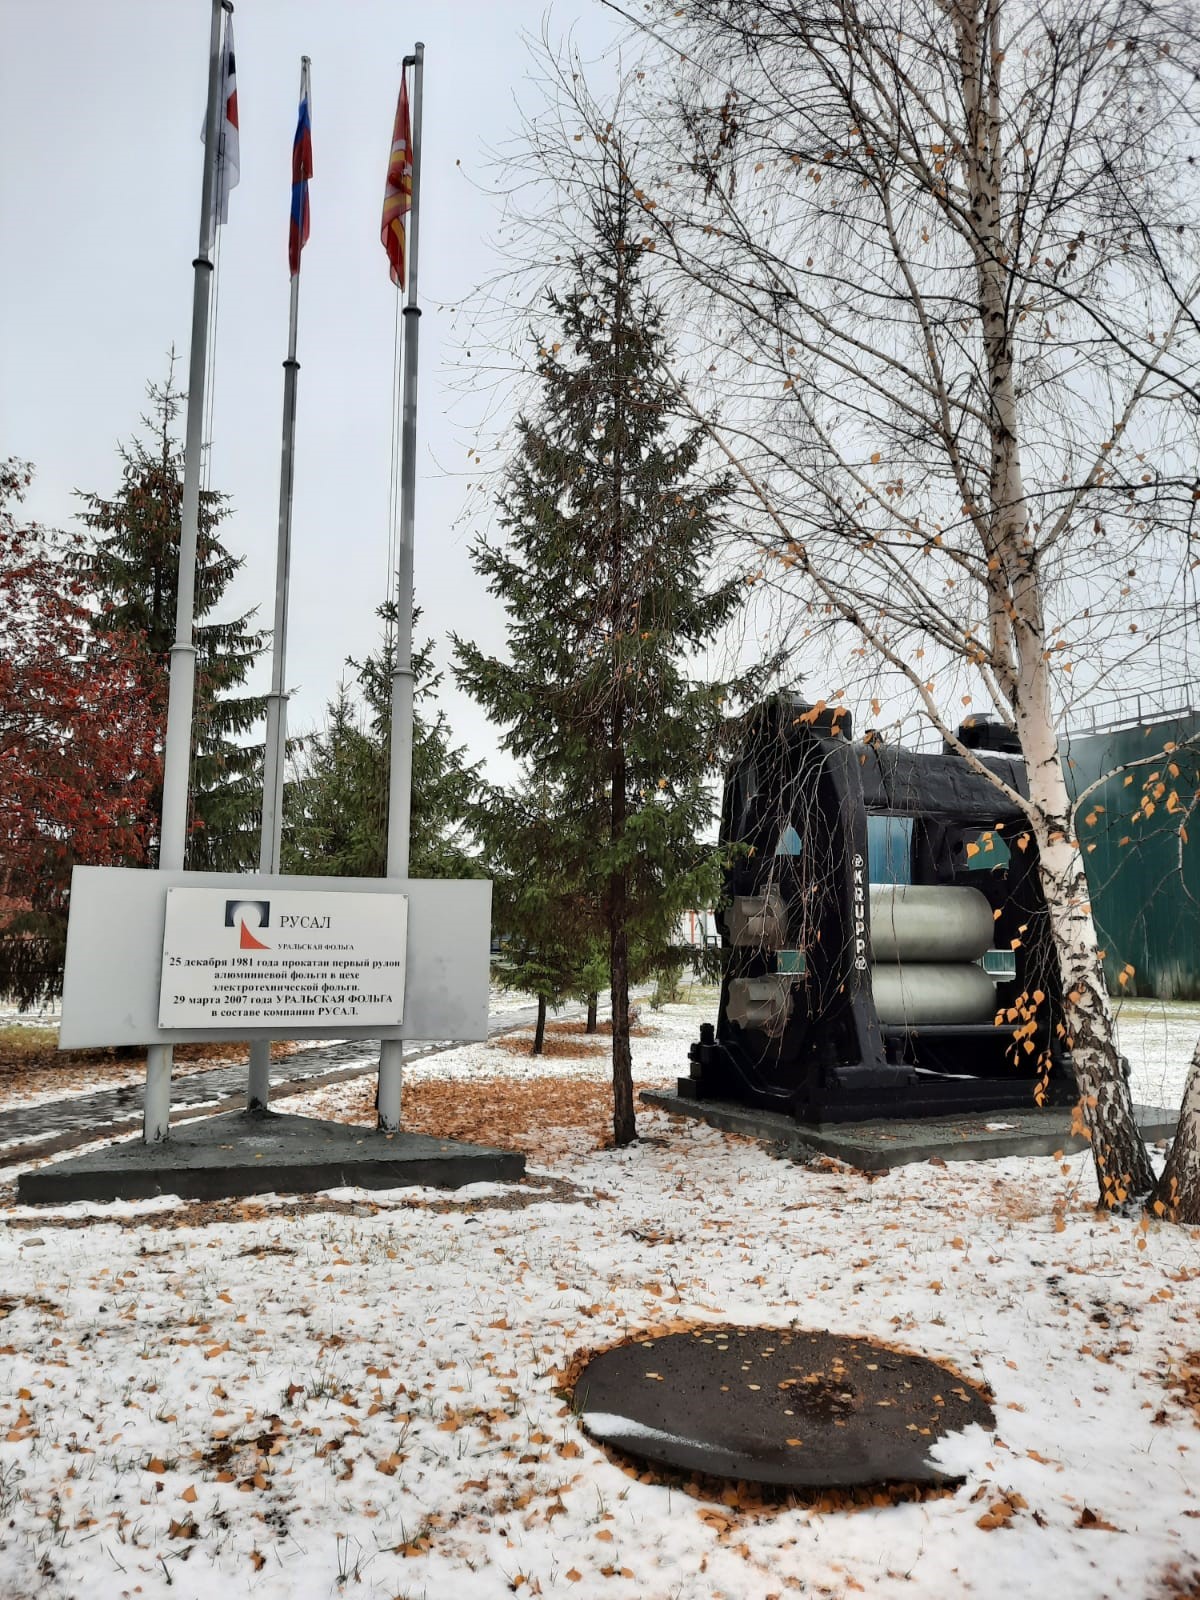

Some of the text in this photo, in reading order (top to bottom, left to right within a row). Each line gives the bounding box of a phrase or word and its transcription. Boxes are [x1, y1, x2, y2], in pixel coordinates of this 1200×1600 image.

[854, 870, 865, 953] KRUPP
[280, 915, 331, 929] РУСАЛ
[169, 957, 400, 969] 25 декабря 1981 года прокатан первый рулон
[214, 970, 287, 980] алюминиевой
[290, 971, 327, 980] фольги
[338, 972, 359, 980] цехе
[213, 983, 360, 993] электротехнической фольги.
[173, 995, 393, 1005] 29 марта 2007 года УРАЛЬСКАЯ ФОЛЬГА
[220, 1009, 261, 1017] составе
[263, 1009, 315, 1017] компании
[318, 1007, 358, 1016] РУСАЛ.
